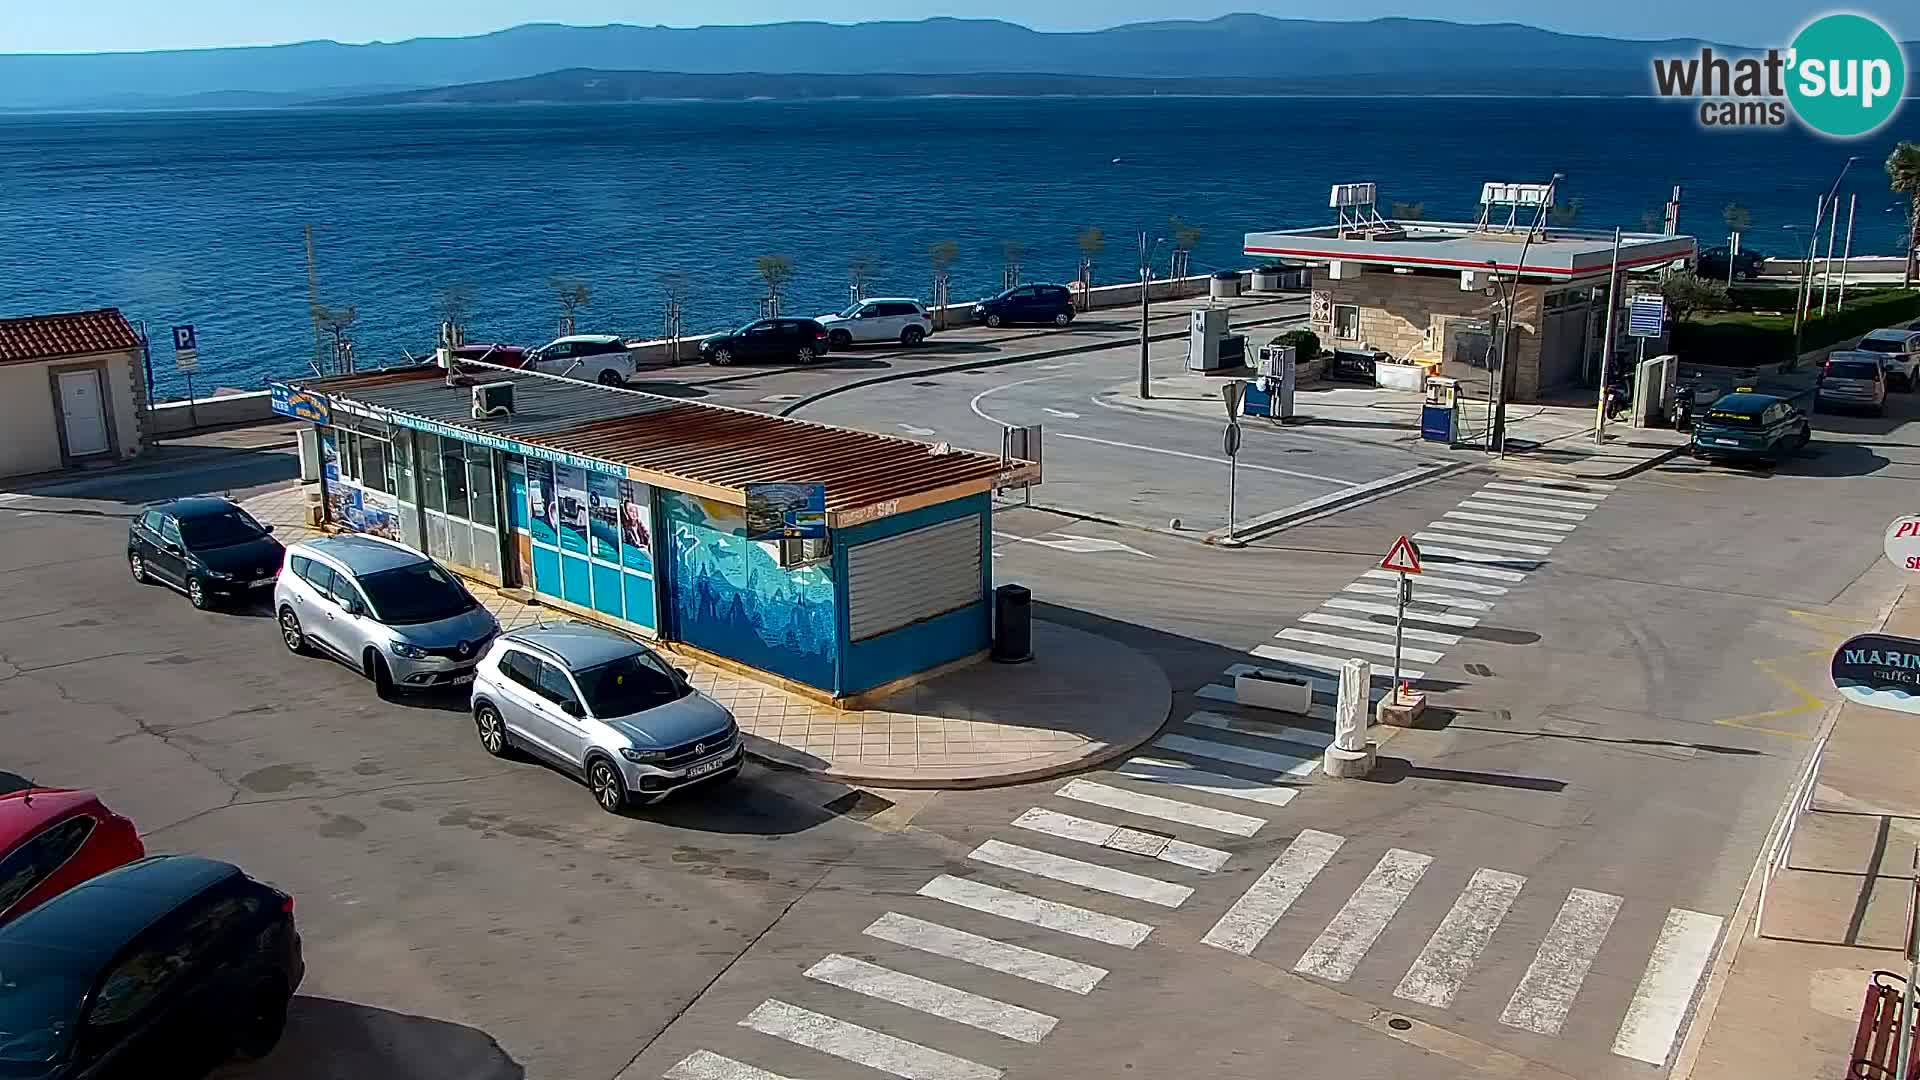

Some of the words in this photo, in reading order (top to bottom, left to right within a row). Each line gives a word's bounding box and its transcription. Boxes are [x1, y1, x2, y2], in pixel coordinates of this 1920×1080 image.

[178, 329, 189, 347] P
[439, 426, 477, 442] AUTOBUSNA
[479, 434, 509, 450] POSTAJA
[519, 443, 534, 456] BUS
[535, 447, 567, 463] STATION
[570, 455, 595, 469] TICKET
[596, 462, 623, 476] OFFICE
